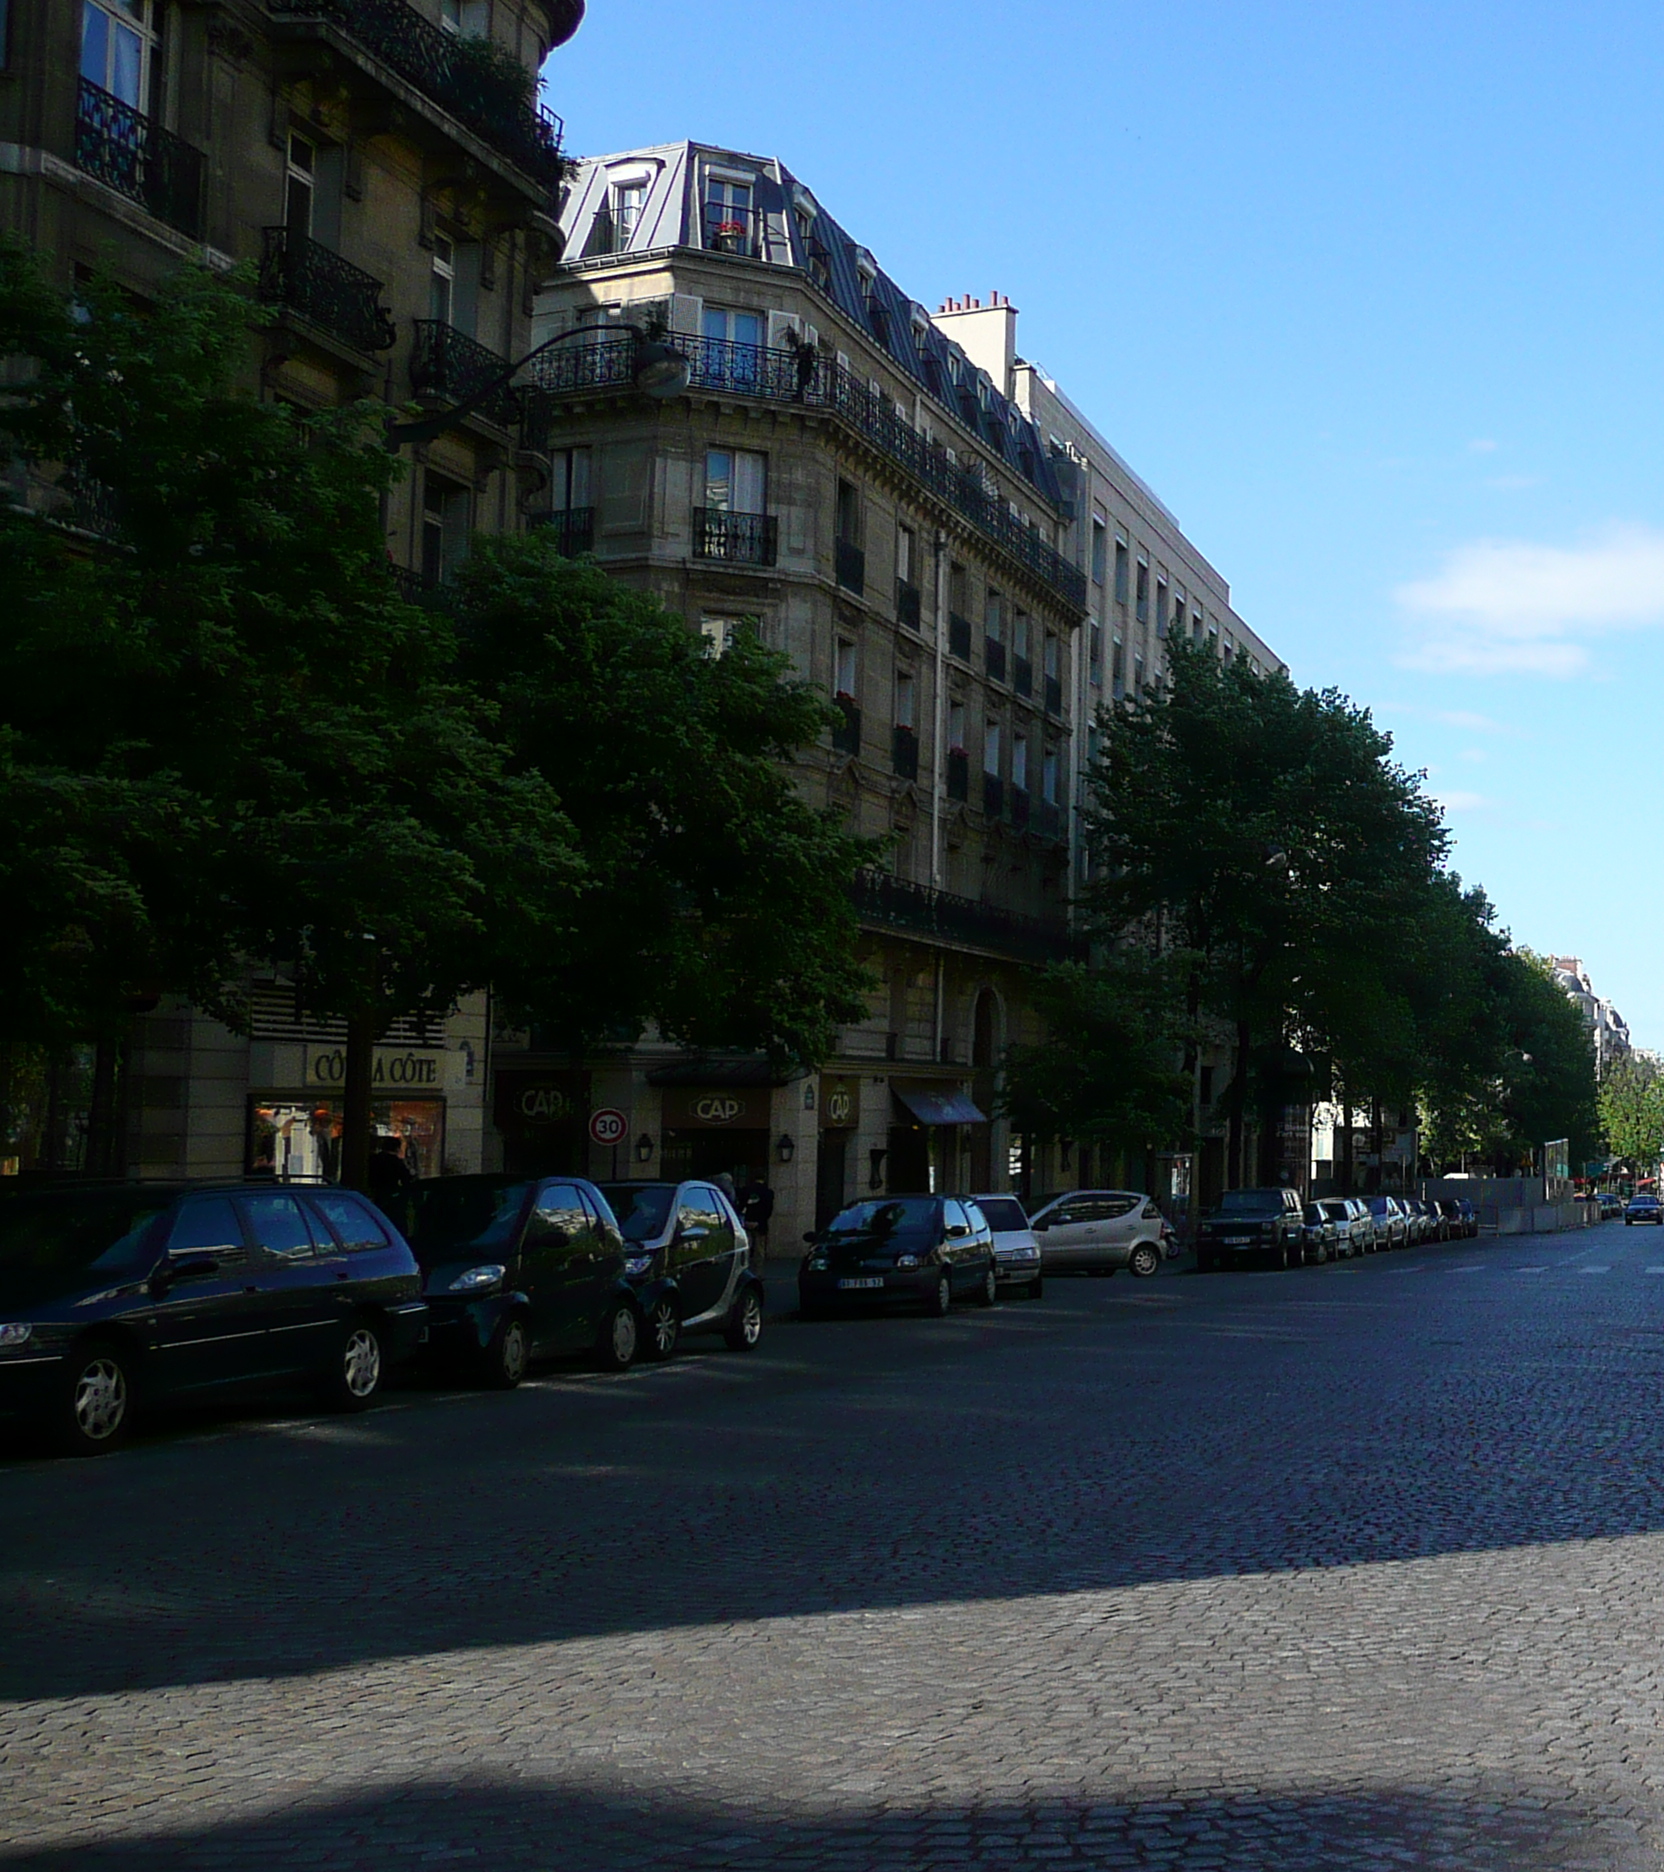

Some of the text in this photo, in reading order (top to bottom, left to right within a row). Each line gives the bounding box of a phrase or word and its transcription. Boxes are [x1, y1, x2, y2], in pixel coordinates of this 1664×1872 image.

[315, 1049, 347, 1082] CÔ
[521, 1090, 563, 1119] CAP
[696, 1099, 738, 1119] CAP
[831, 1094, 849, 1120] CAP
[598, 1119, 619, 1134] 30
